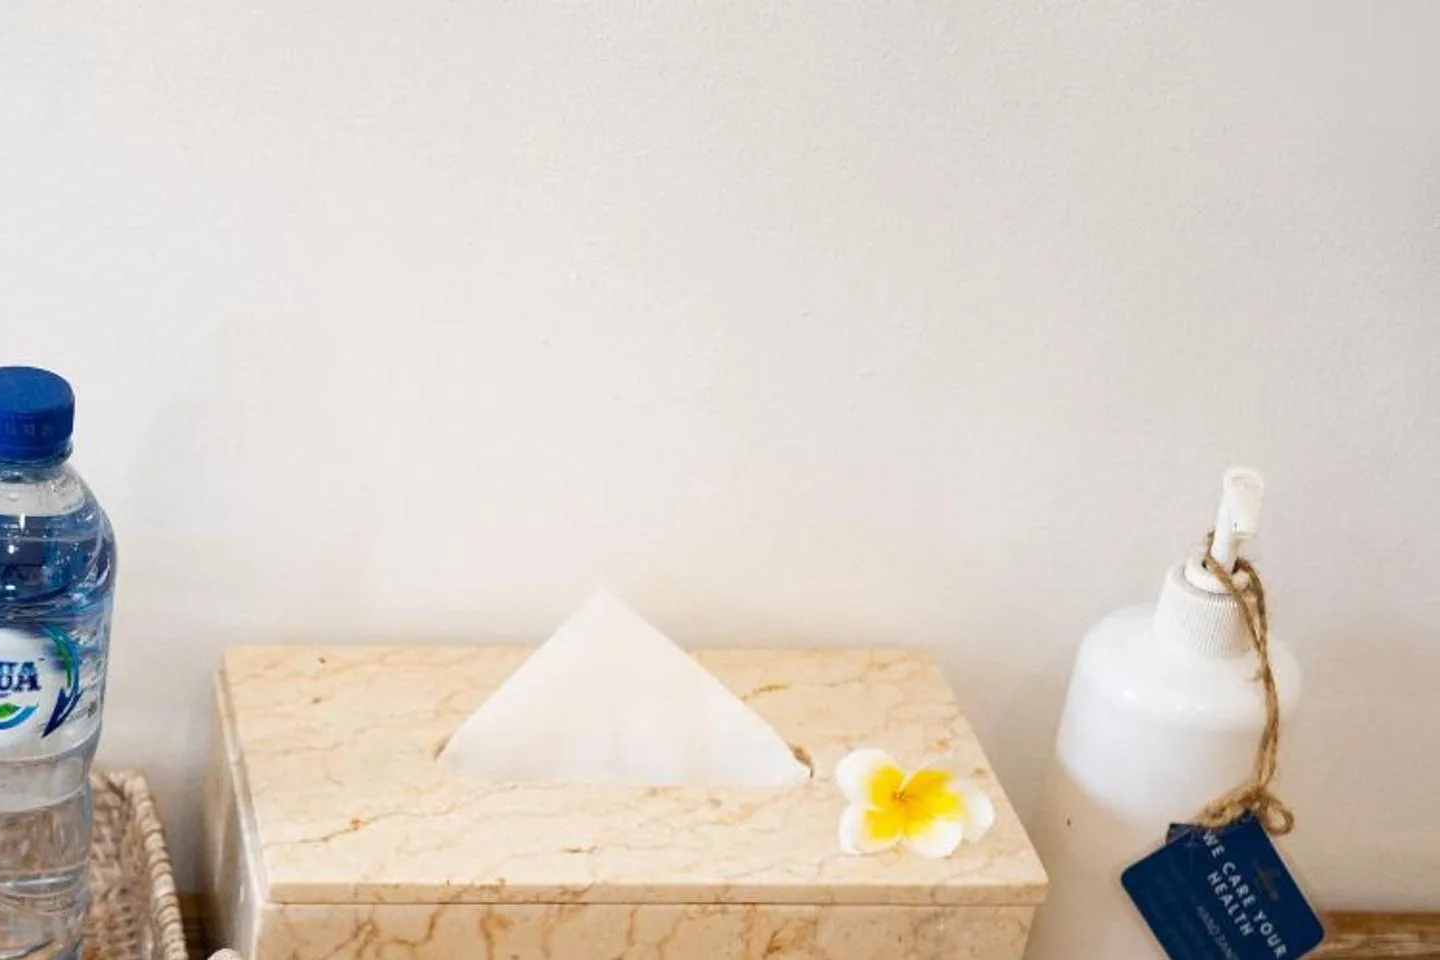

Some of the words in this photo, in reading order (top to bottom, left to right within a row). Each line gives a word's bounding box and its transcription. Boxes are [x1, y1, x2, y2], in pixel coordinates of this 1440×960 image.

[1203, 830, 1225, 859] WE
[1222, 861, 1256, 907] CARE
[1253, 910, 1288, 960] YOUR
[1207, 870, 1255, 937] HEALTH
